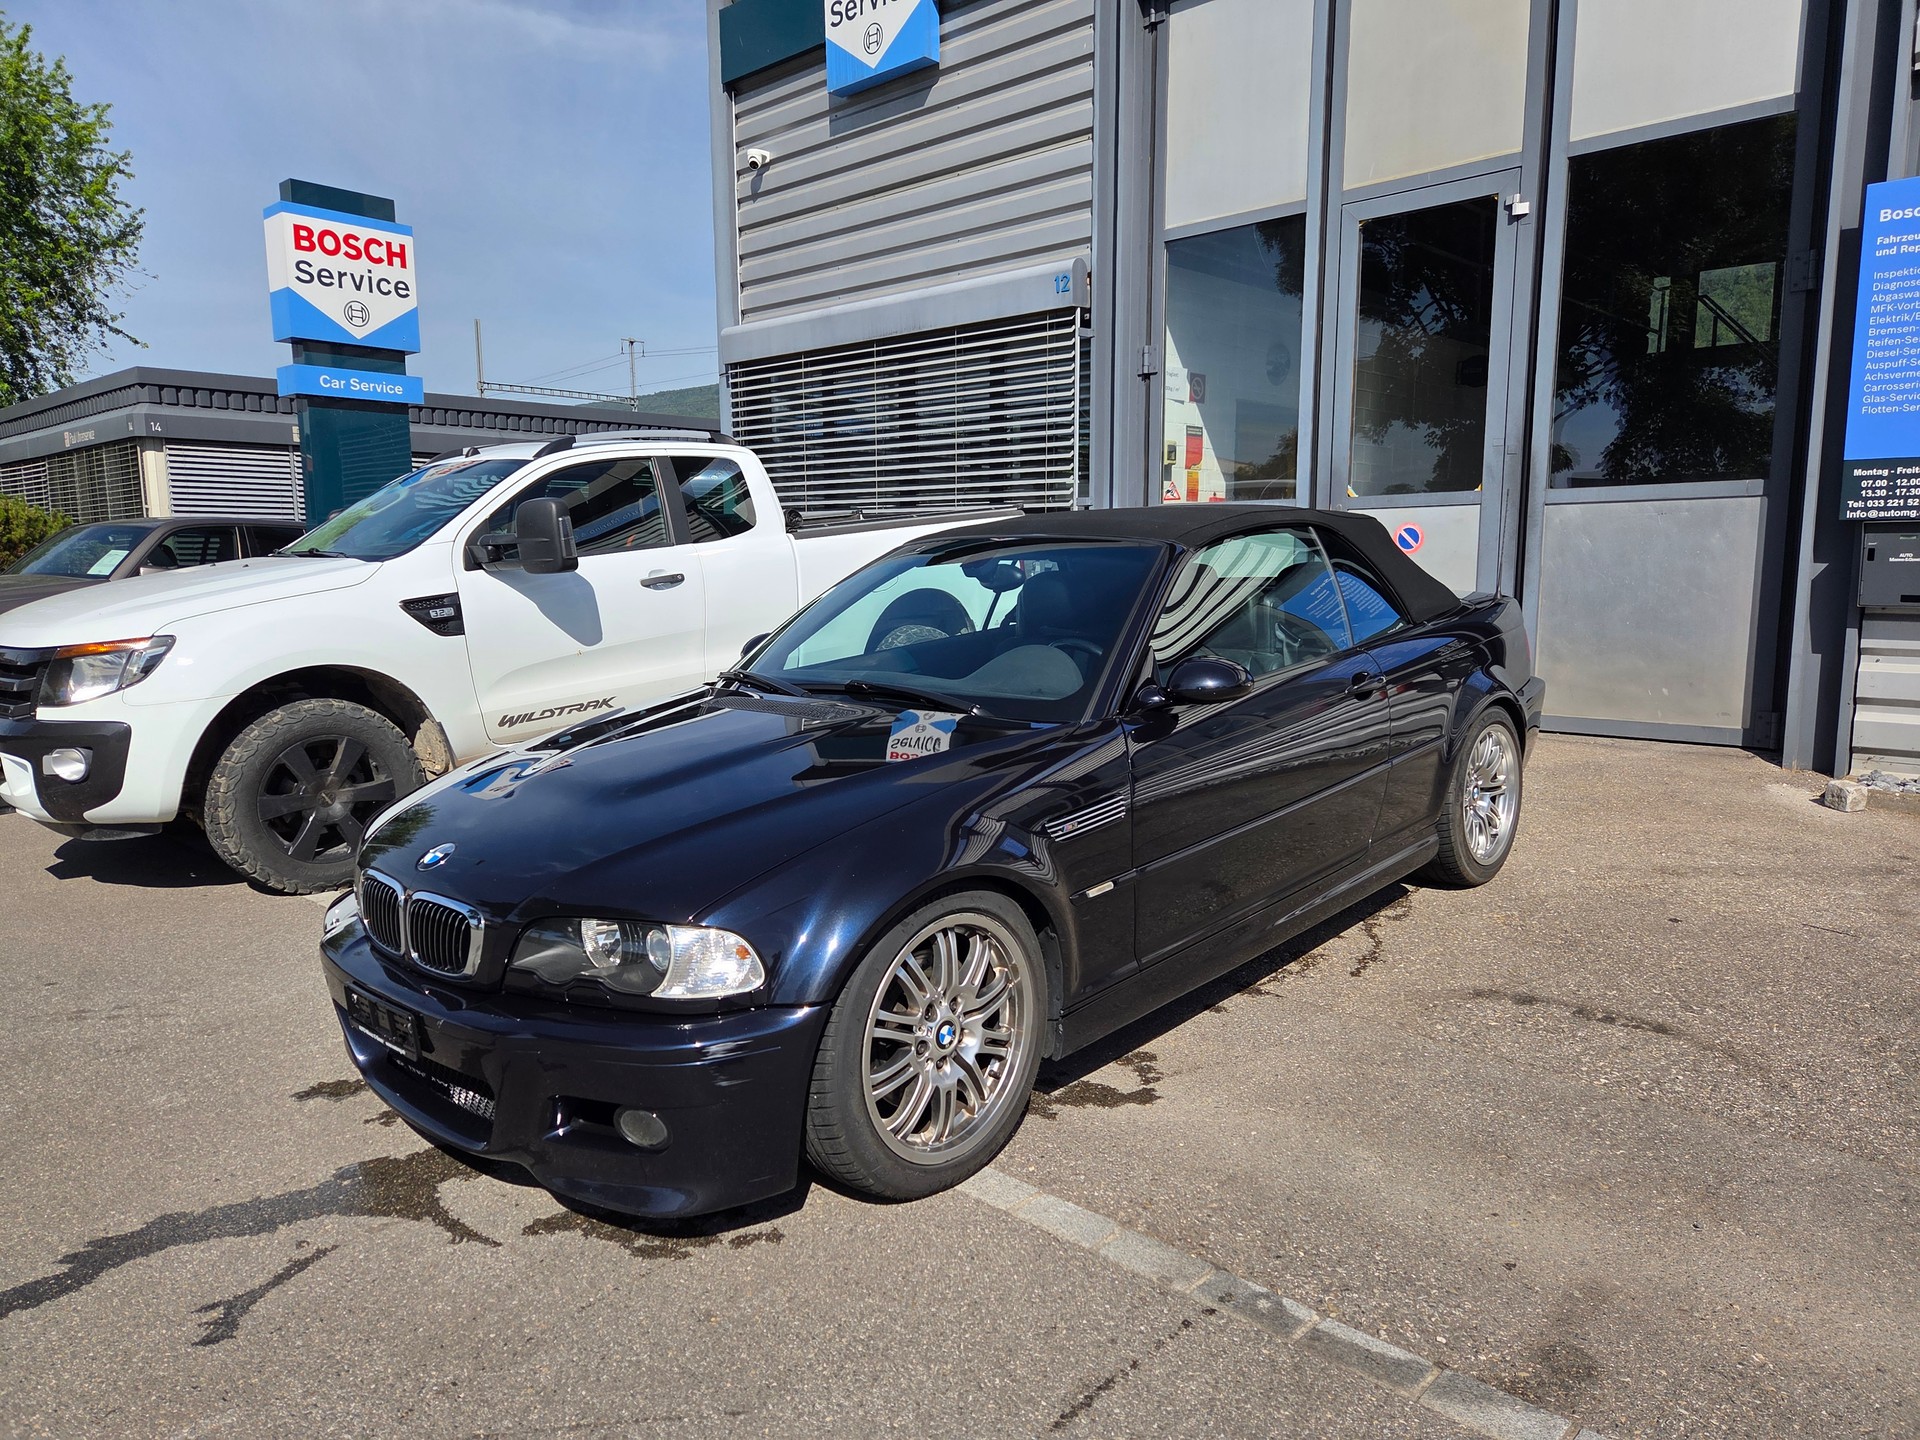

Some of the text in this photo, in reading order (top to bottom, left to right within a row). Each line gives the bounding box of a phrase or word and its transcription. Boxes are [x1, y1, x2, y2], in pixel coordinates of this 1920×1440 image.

[830, 0, 899, 28] Serv
[1876, 233, 1920, 245] Fahrzeu
[293, 223, 407, 269] BOSCH
[1875, 244, 1920, 256] und Rep
[294, 259, 410, 299] Service
[1054, 273, 1070, 294] 12
[1871, 290, 1920, 302] Abgaswa
[1870, 301, 1920, 314] MFK-Vorb
[319, 375, 403, 395] Car Service
[1863, 380, 1920, 392] Carrosseri
[150, 421, 162, 432] 14
[1853, 468, 1889, 477] Montag
[1896, 466, 1920, 475] Freit
[1861, 479, 1887, 487] 07.00
[1895, 478, 1920, 486] 12.00
[1860, 489, 1887, 497] 13.30
[1894, 488, 1920, 496] 17.30
[1847, 500, 1865, 508] Tel:
[1907, 498, 1920, 506] 52
[1846, 509, 1920, 519] Info@automg.
[497, 696, 617, 728] WILDTRAK
